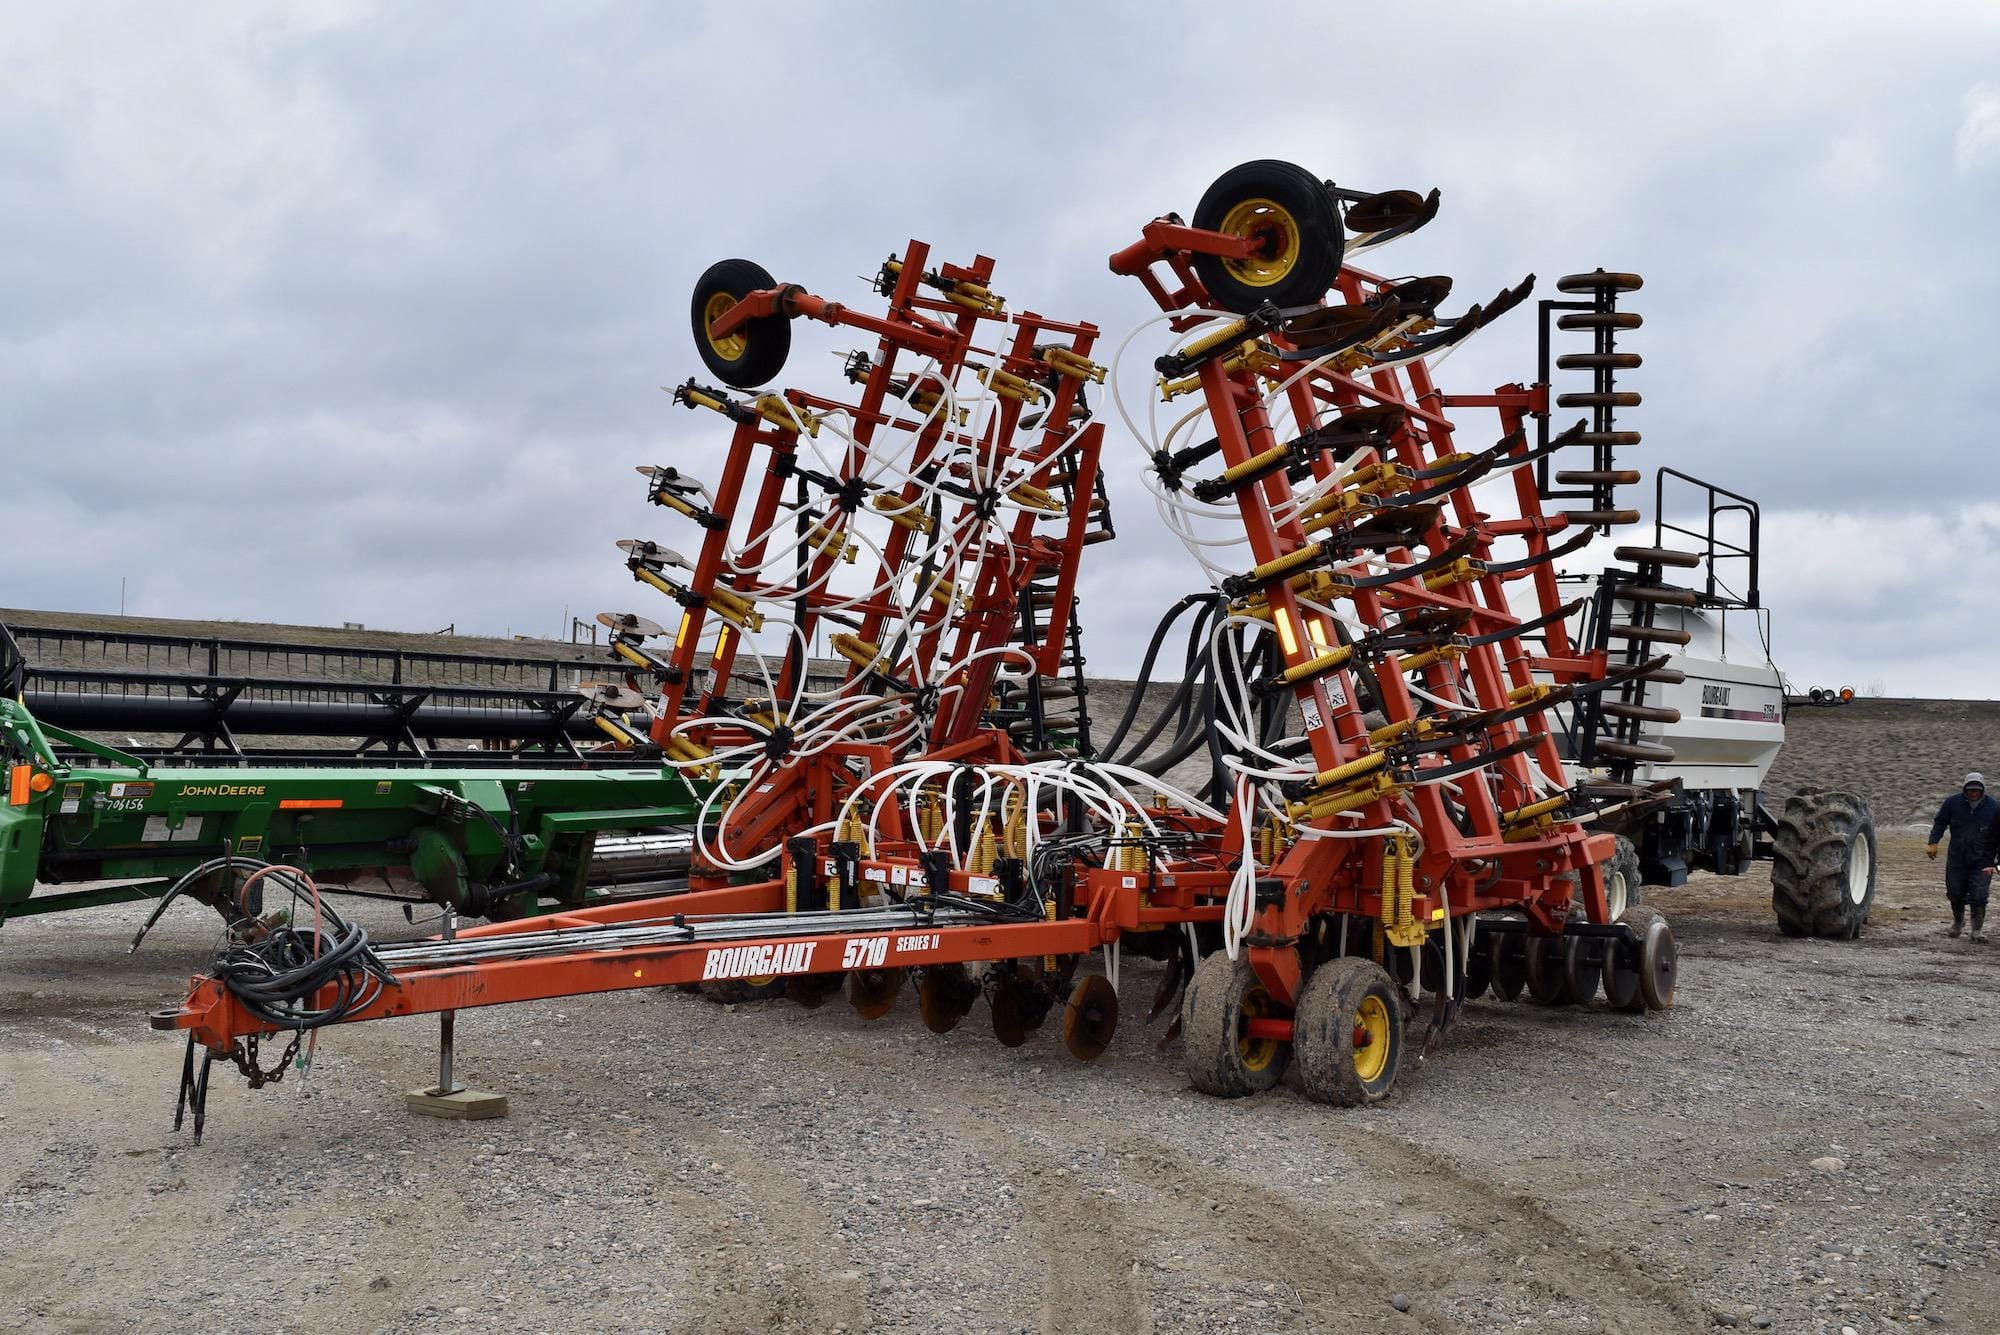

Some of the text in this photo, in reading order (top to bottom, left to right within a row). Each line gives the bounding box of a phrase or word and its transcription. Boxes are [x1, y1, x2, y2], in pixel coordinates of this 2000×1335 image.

[177, 785, 266, 796] JOHN DEERE
[106, 798, 144, 811] 706156
[702, 941, 817, 981] BOURGAULT
[842, 936, 889, 969] 5710
[896, 936, 930, 952] SERIES
